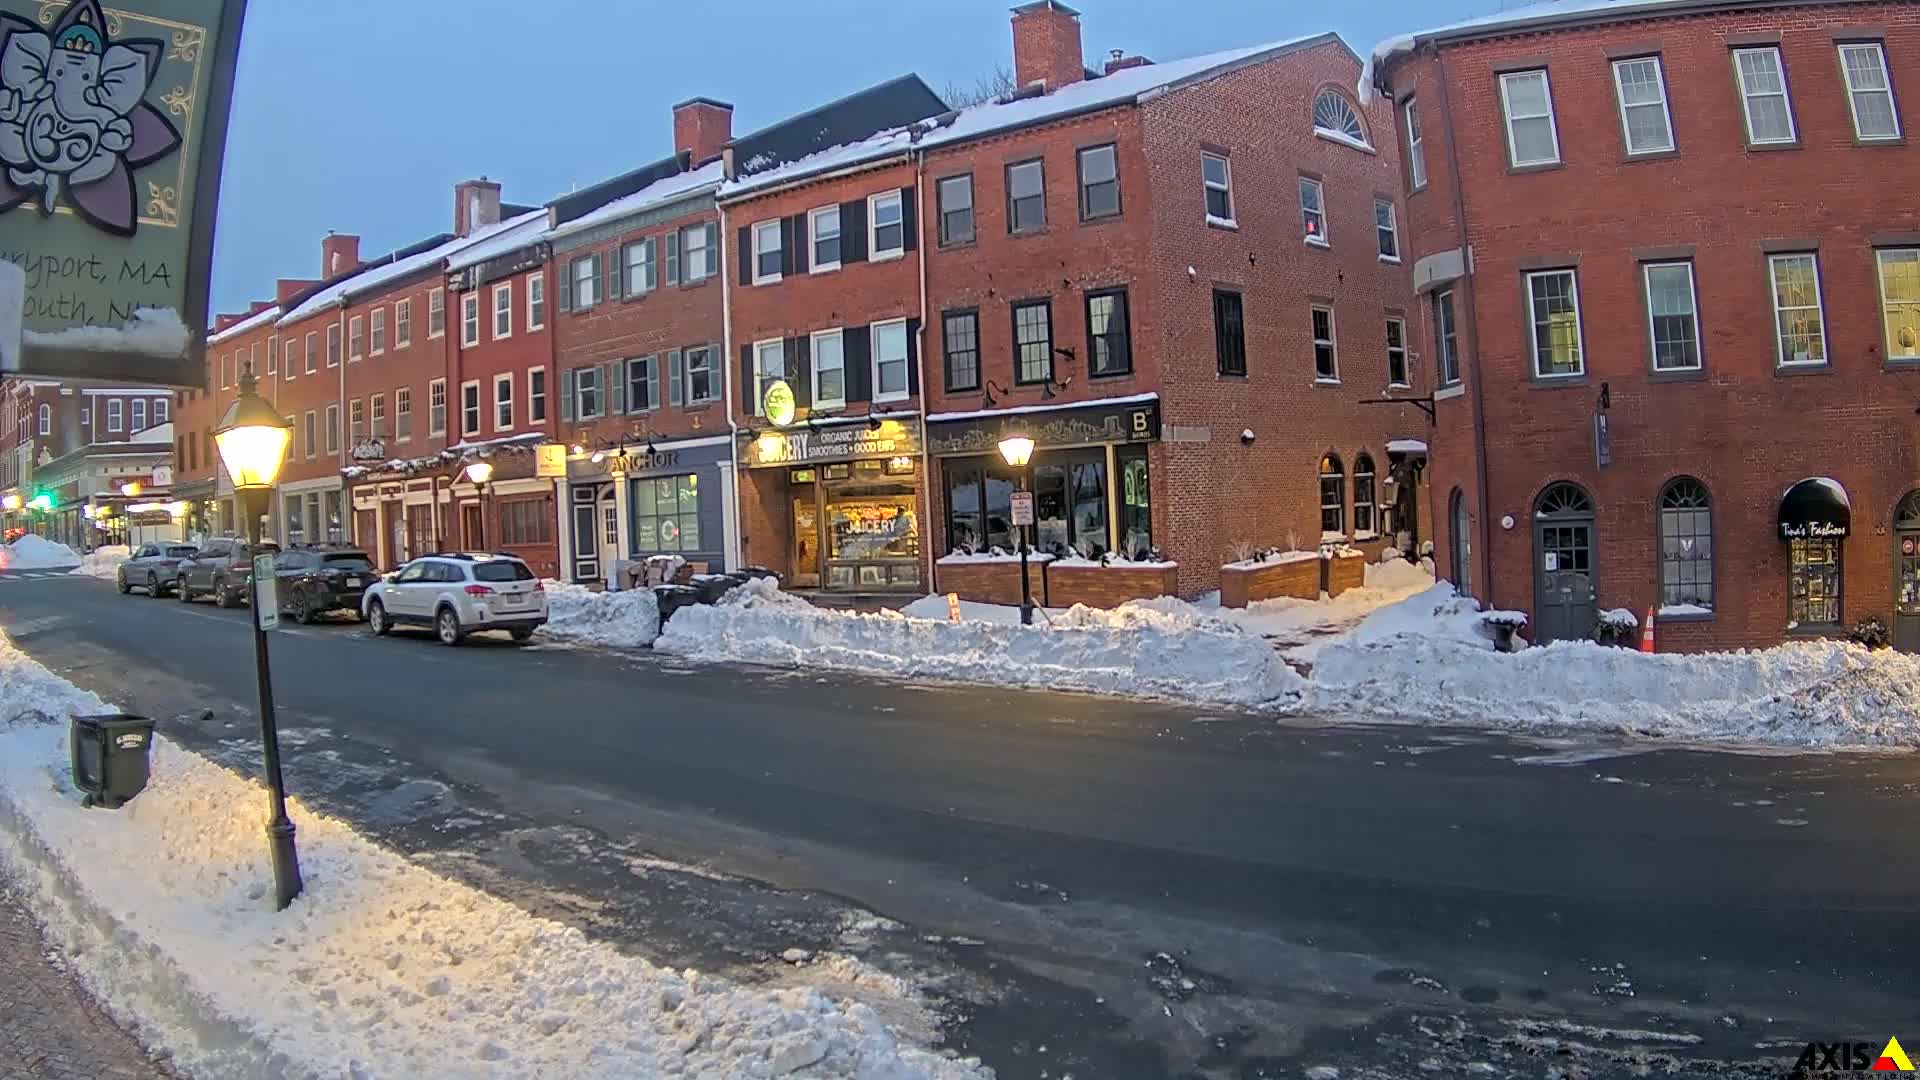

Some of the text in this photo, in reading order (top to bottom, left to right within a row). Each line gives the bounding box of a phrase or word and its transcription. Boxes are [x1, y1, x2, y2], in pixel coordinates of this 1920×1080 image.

[0, 251, 171, 291] ryport, MA
[23, 291, 155, 326] outh, N
[820, 431, 852, 443] ORGANIC
[808, 443, 849, 458] SMOOTHIES
[854, 441, 877, 454] GOOD
[611, 449, 679, 472] ANCHOR
[845, 518, 897, 534] JUICERY
[1781, 521, 1846, 537] Tina's Fashions
